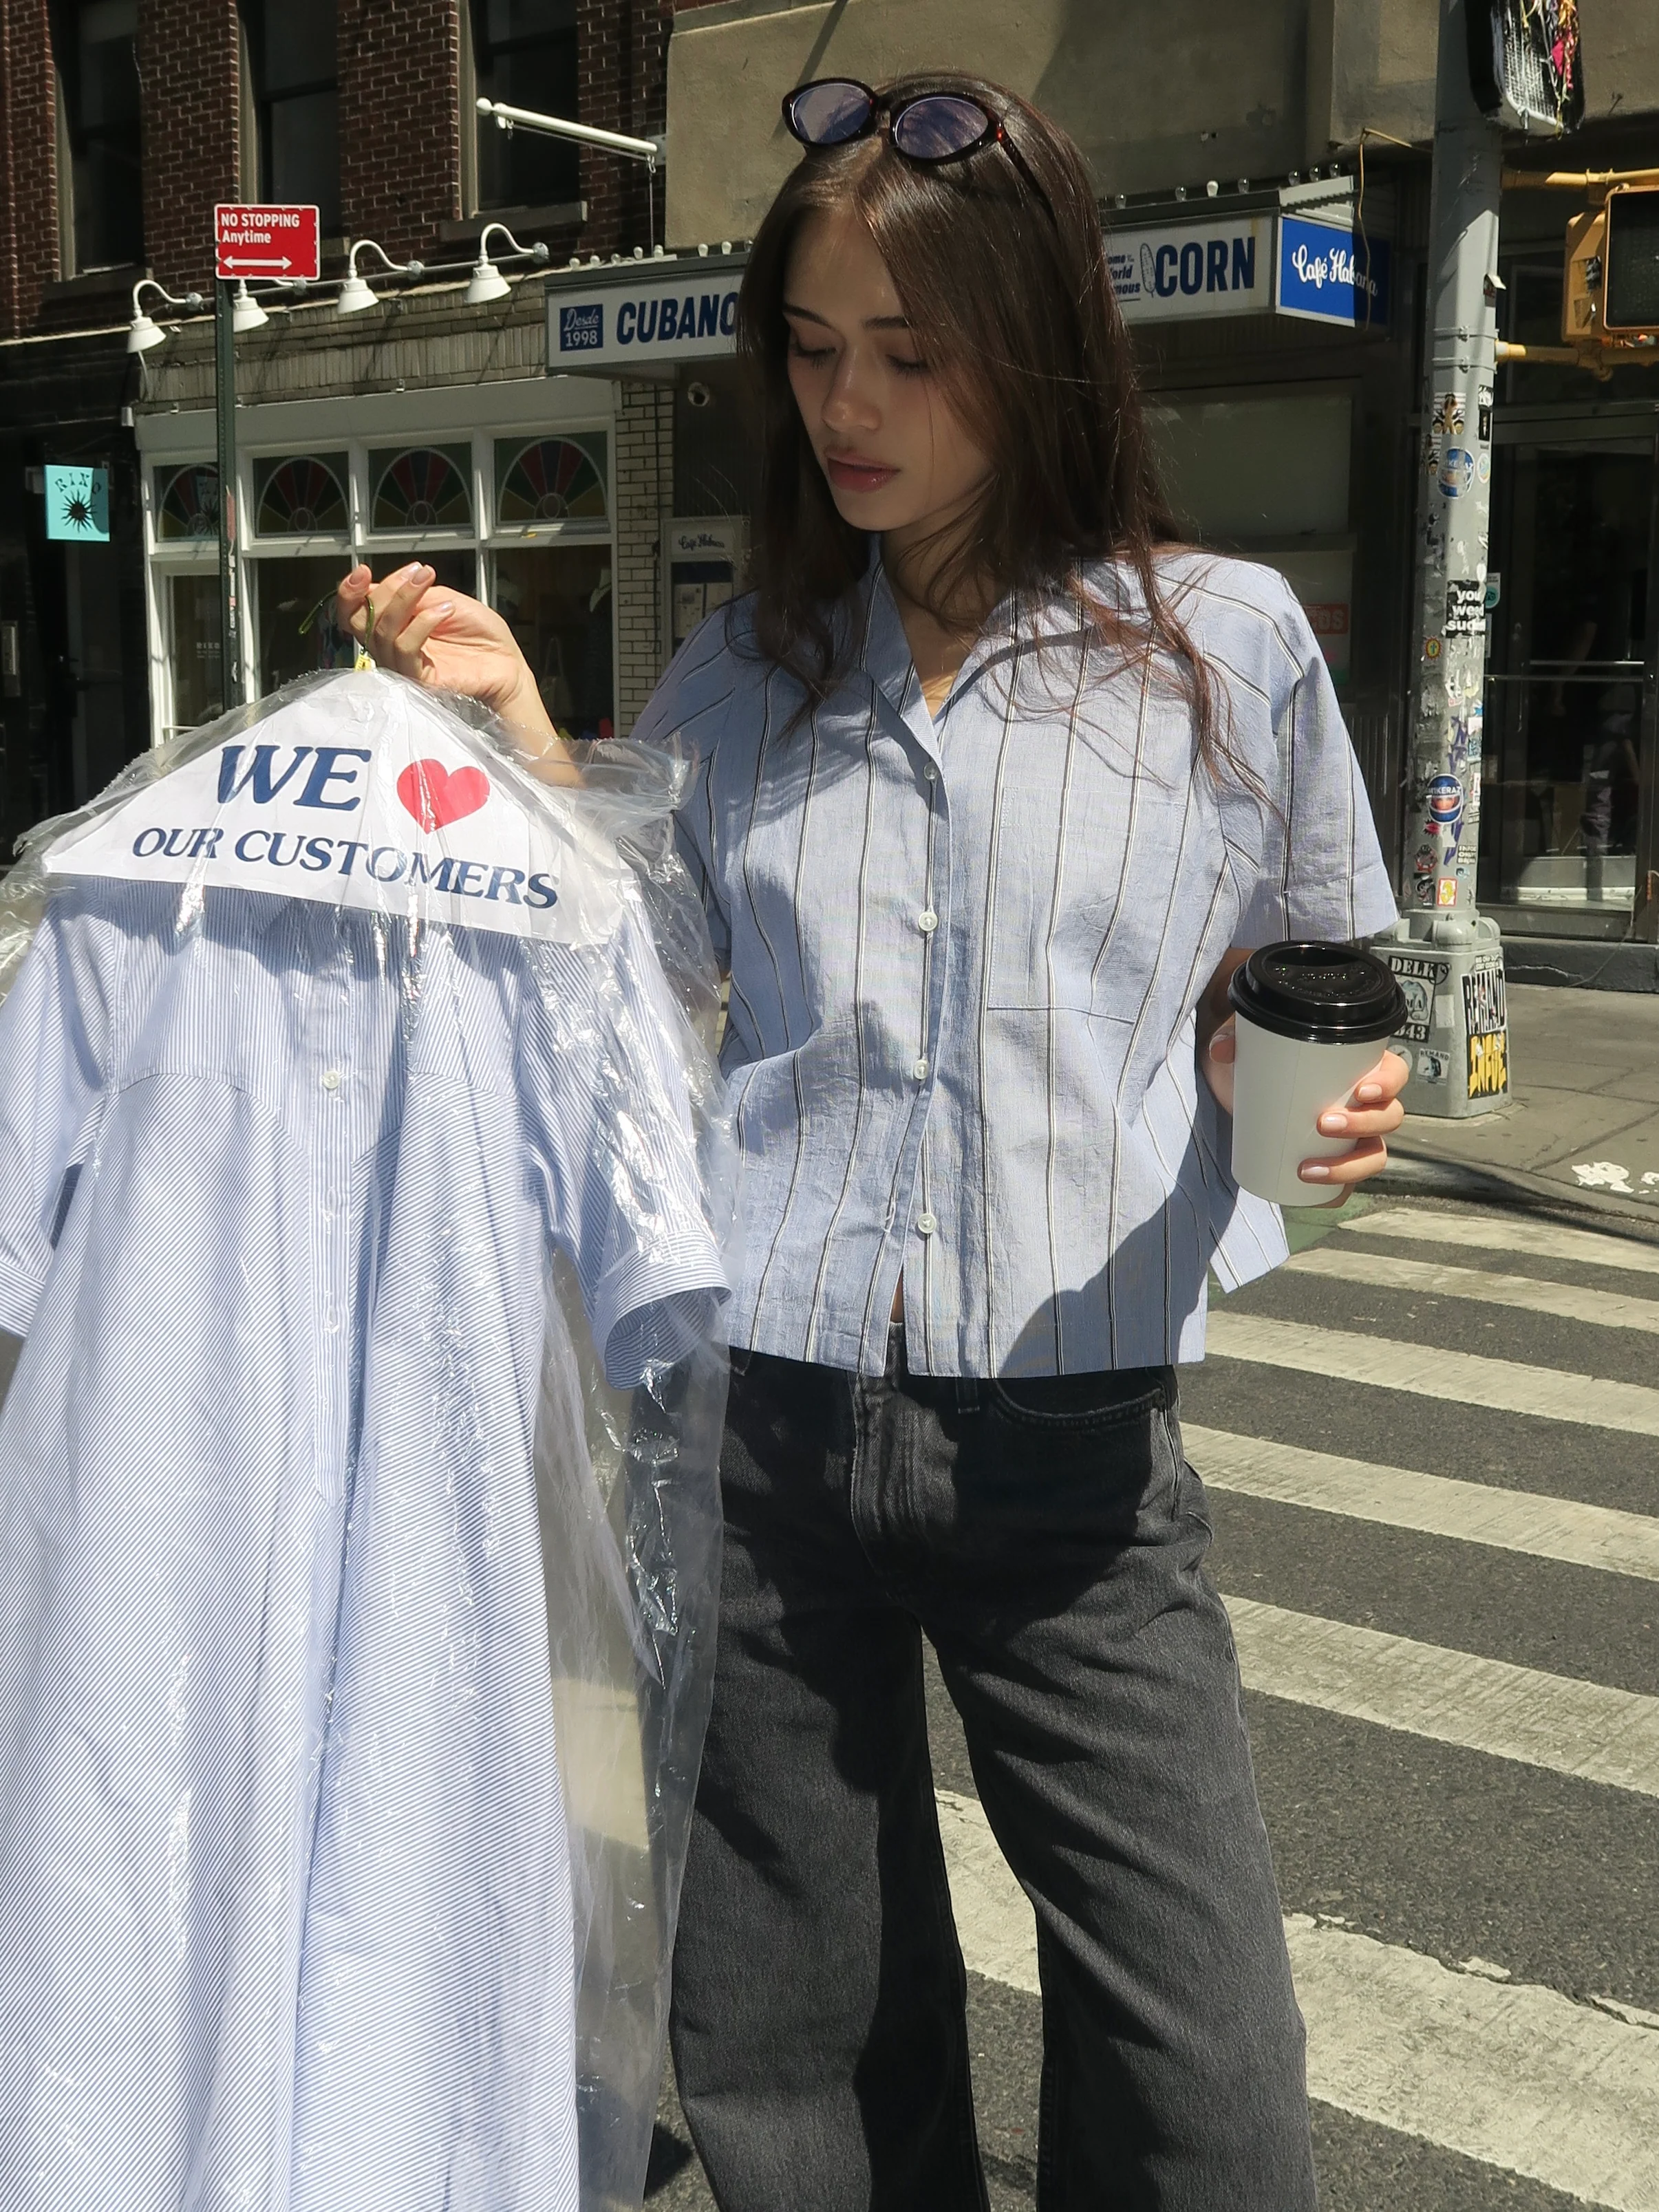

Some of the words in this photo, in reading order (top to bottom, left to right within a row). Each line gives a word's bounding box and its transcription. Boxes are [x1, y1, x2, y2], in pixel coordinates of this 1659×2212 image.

[221, 213, 238, 226] NO
[241, 213, 300, 227] STOPPING
[222, 230, 271, 246] Anytime
[1107, 255, 1126, 264] ome
[1155, 237, 1256, 297] CORN
[1292, 244, 1328, 289] Café
[1329, 248, 1378, 297] Habana
[1110, 265, 1133, 279] orld
[564, 308, 599, 332] Desde
[566, 330, 598, 347] 1998
[55, 472, 101, 494] RIXO
[217, 744, 372, 811] WE
[132, 828, 224, 858] OUR
[235, 830, 559, 909] CUSTOMERS
